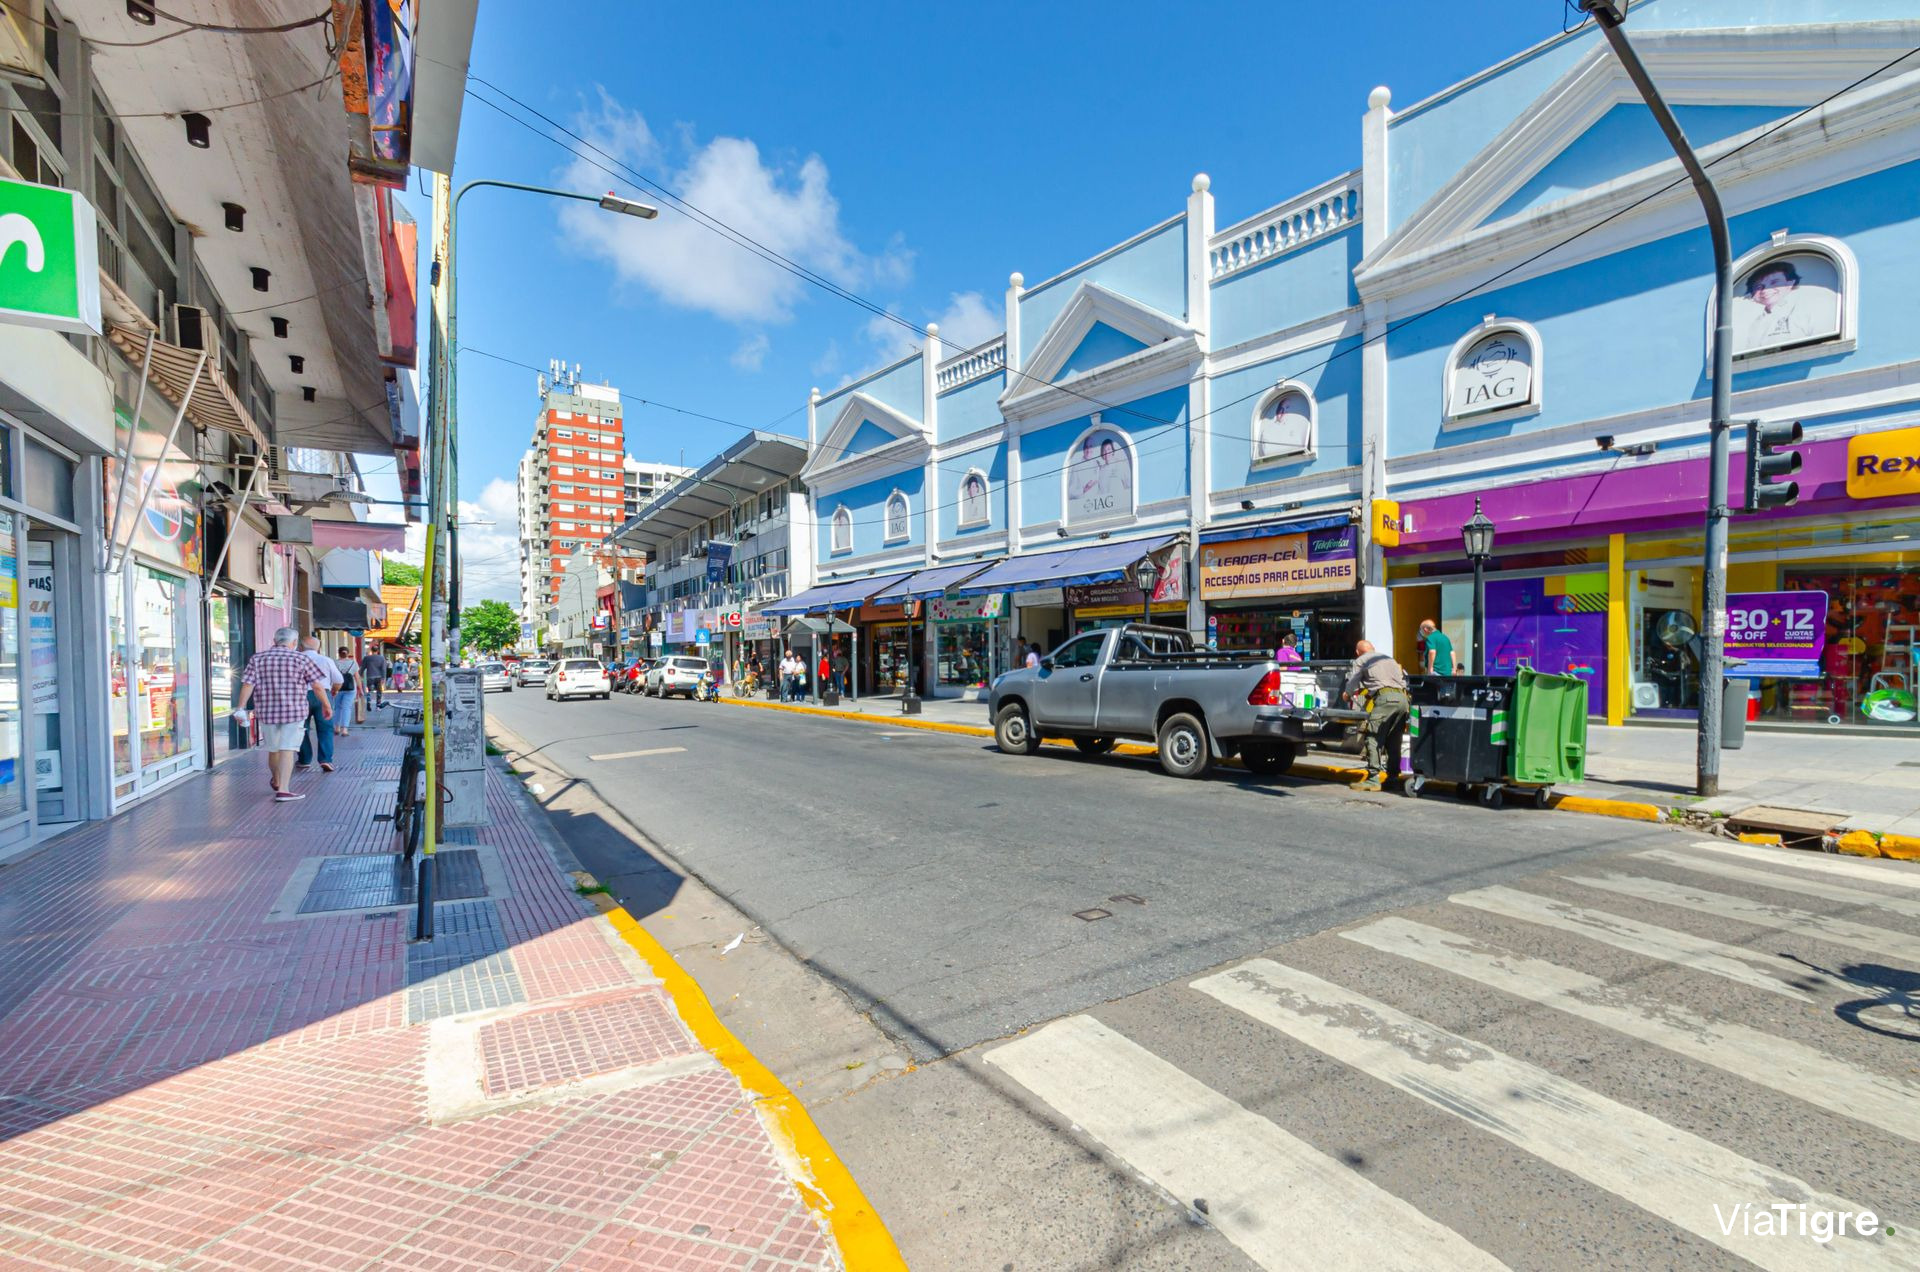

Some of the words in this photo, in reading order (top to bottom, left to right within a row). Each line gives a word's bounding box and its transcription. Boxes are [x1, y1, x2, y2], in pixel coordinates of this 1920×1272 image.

[1463, 377, 1515, 406] IAG
[1094, 495, 1114, 510] IAG
[891, 521, 905, 534] IAG
[1217, 550, 1298, 568] LEADER-CEL
[1204, 573, 1261, 587] ACCESORIOS
[1263, 570, 1289, 582] PARA
[1291, 565, 1351, 581] CELULARES
[1780, 609, 1814, 630] 12
[1744, 631, 1767, 640] OFF
